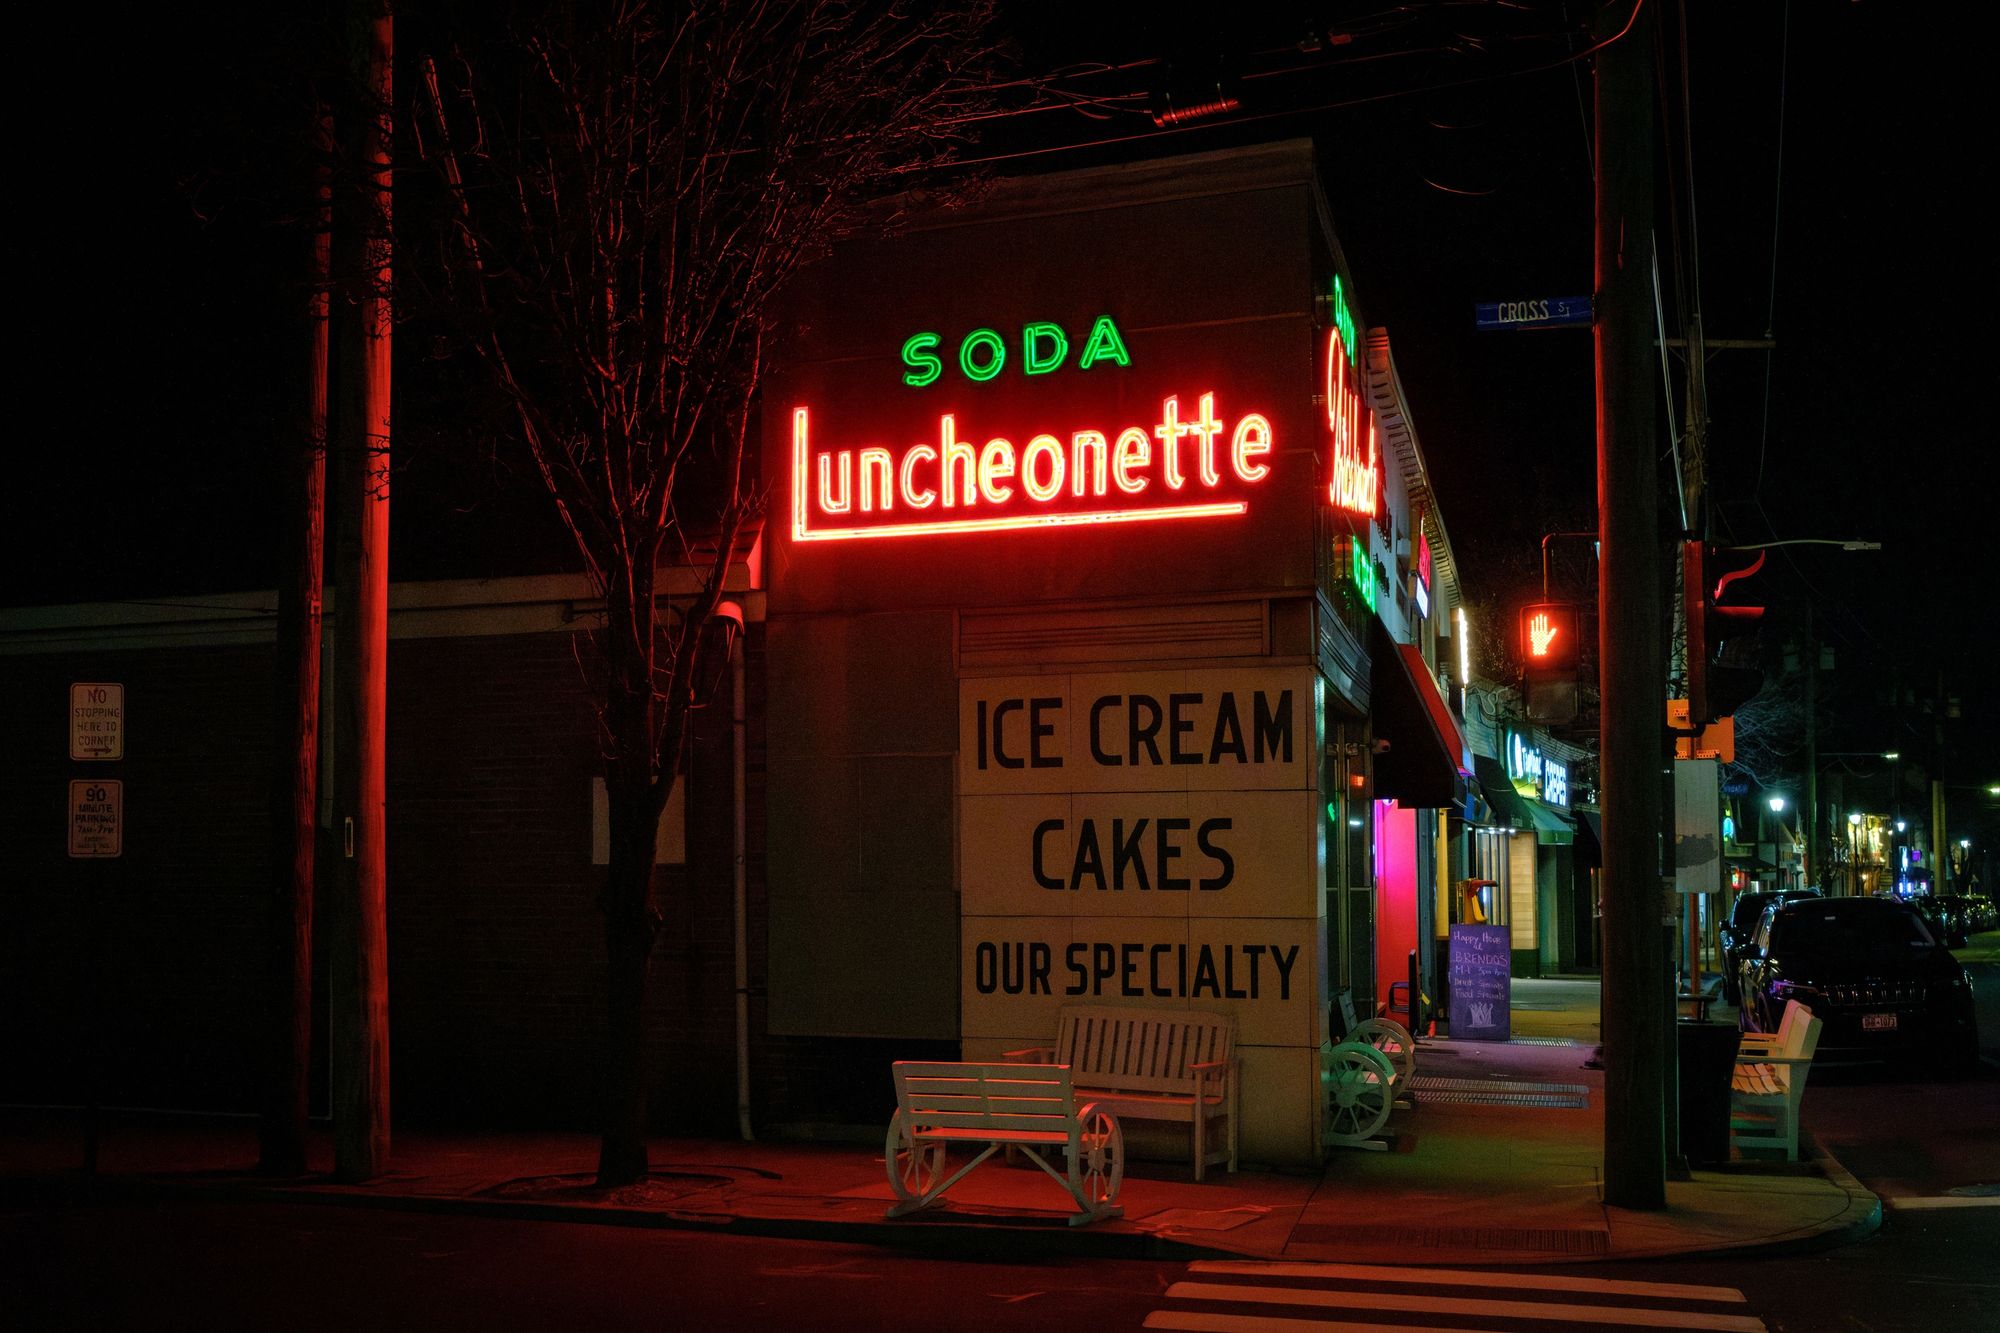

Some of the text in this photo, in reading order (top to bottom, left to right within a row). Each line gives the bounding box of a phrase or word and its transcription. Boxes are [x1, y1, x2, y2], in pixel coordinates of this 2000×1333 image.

[1498, 299, 1550, 321] CROSS
[902, 315, 1131, 387] SODA
[792, 391, 1273, 542] Luncheonette
[88, 689, 106, 704] NO
[74, 707, 120, 718] STOPPING
[77, 721, 117, 732] HERE TO
[977, 689, 1293, 770] ICE CREAM
[78, 735, 116, 746] CORNER
[86, 787, 106, 802] 90
[78, 804, 113, 813] MINUTE
[75, 814, 115, 823] PARKING
[1032, 817, 1235, 891] CAKES
[1453, 930, 1479, 944] Happy
[975, 941, 1300, 1001] OUR SPECIALTY
